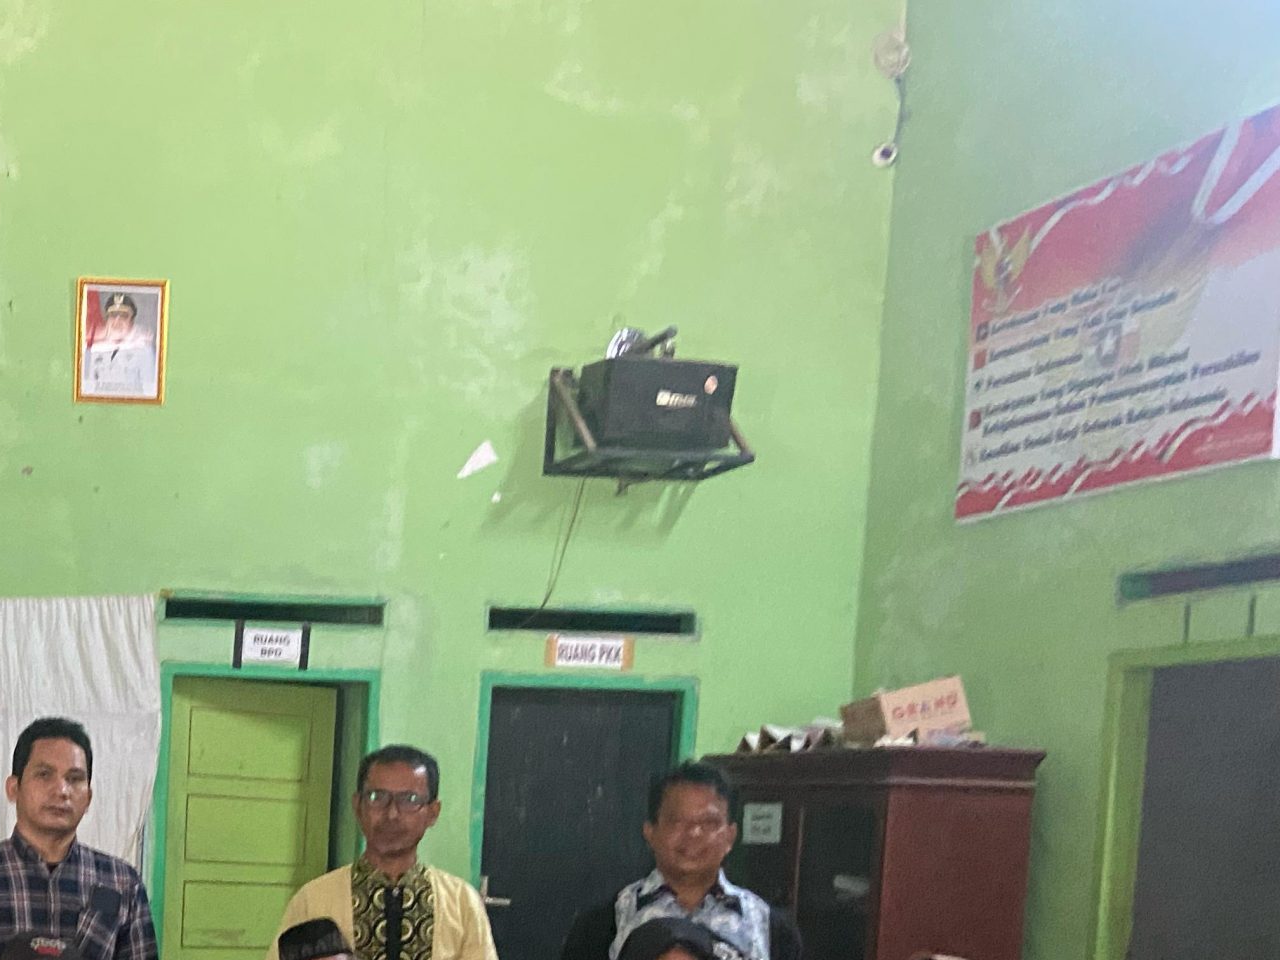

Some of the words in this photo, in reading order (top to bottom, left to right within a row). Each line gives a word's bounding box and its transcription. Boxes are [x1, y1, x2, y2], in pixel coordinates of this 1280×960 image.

[253, 634, 291, 646] RUANG
[558, 643, 596, 662] RUANG
[600, 644, 622, 663] PKK
